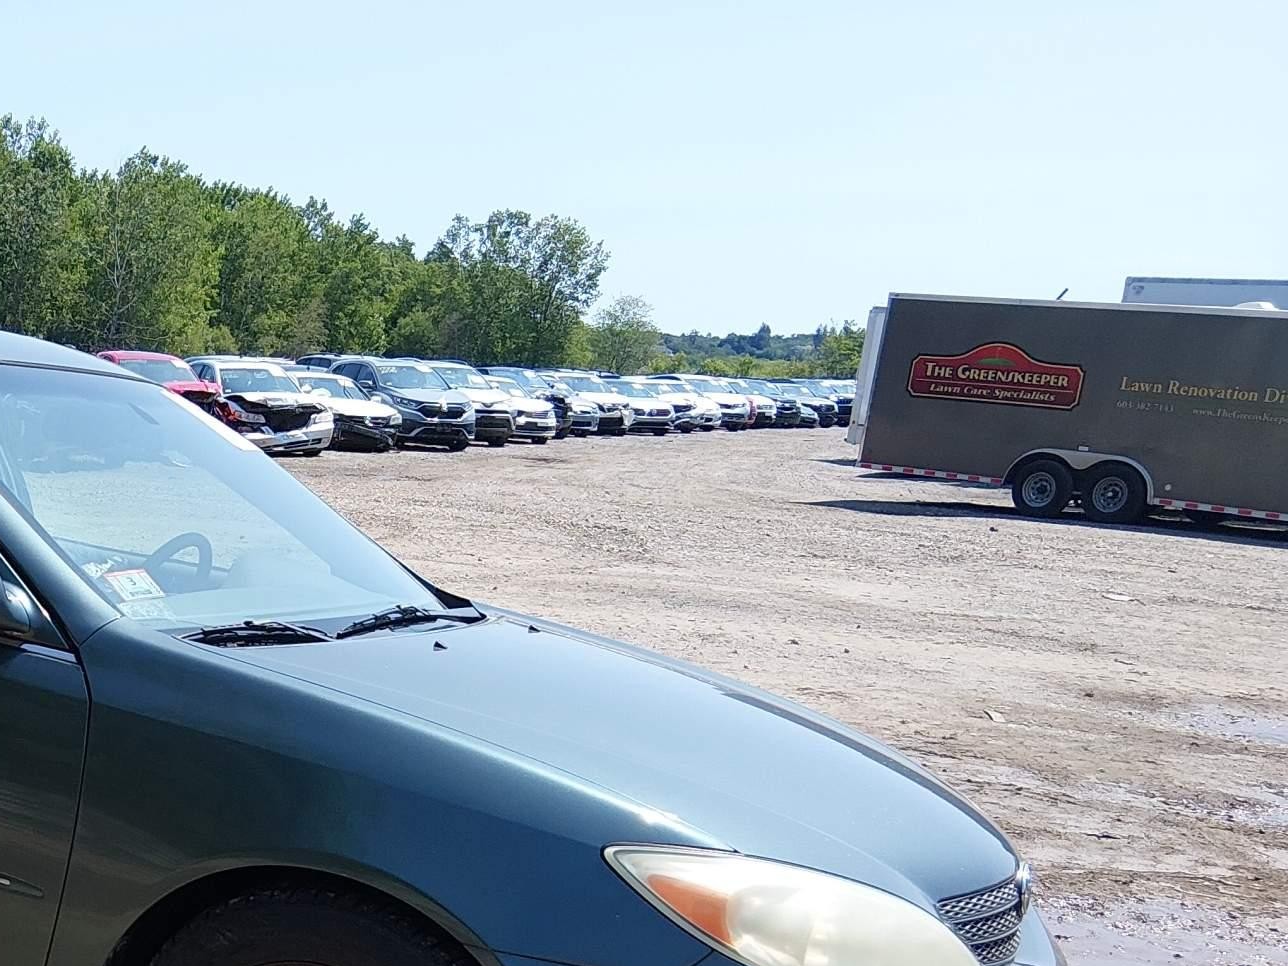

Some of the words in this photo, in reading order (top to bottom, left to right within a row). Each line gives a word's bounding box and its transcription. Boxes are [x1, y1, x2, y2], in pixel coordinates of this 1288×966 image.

[929, 383, 960, 393] Lawn
[964, 386, 990, 396] Care
[992, 388, 1056, 402] Specialists
[1120, 376, 1162, 393] Lawn
[1168, 380, 1258, 402] Renovation
[1264, 387, 1288, 404] Di
